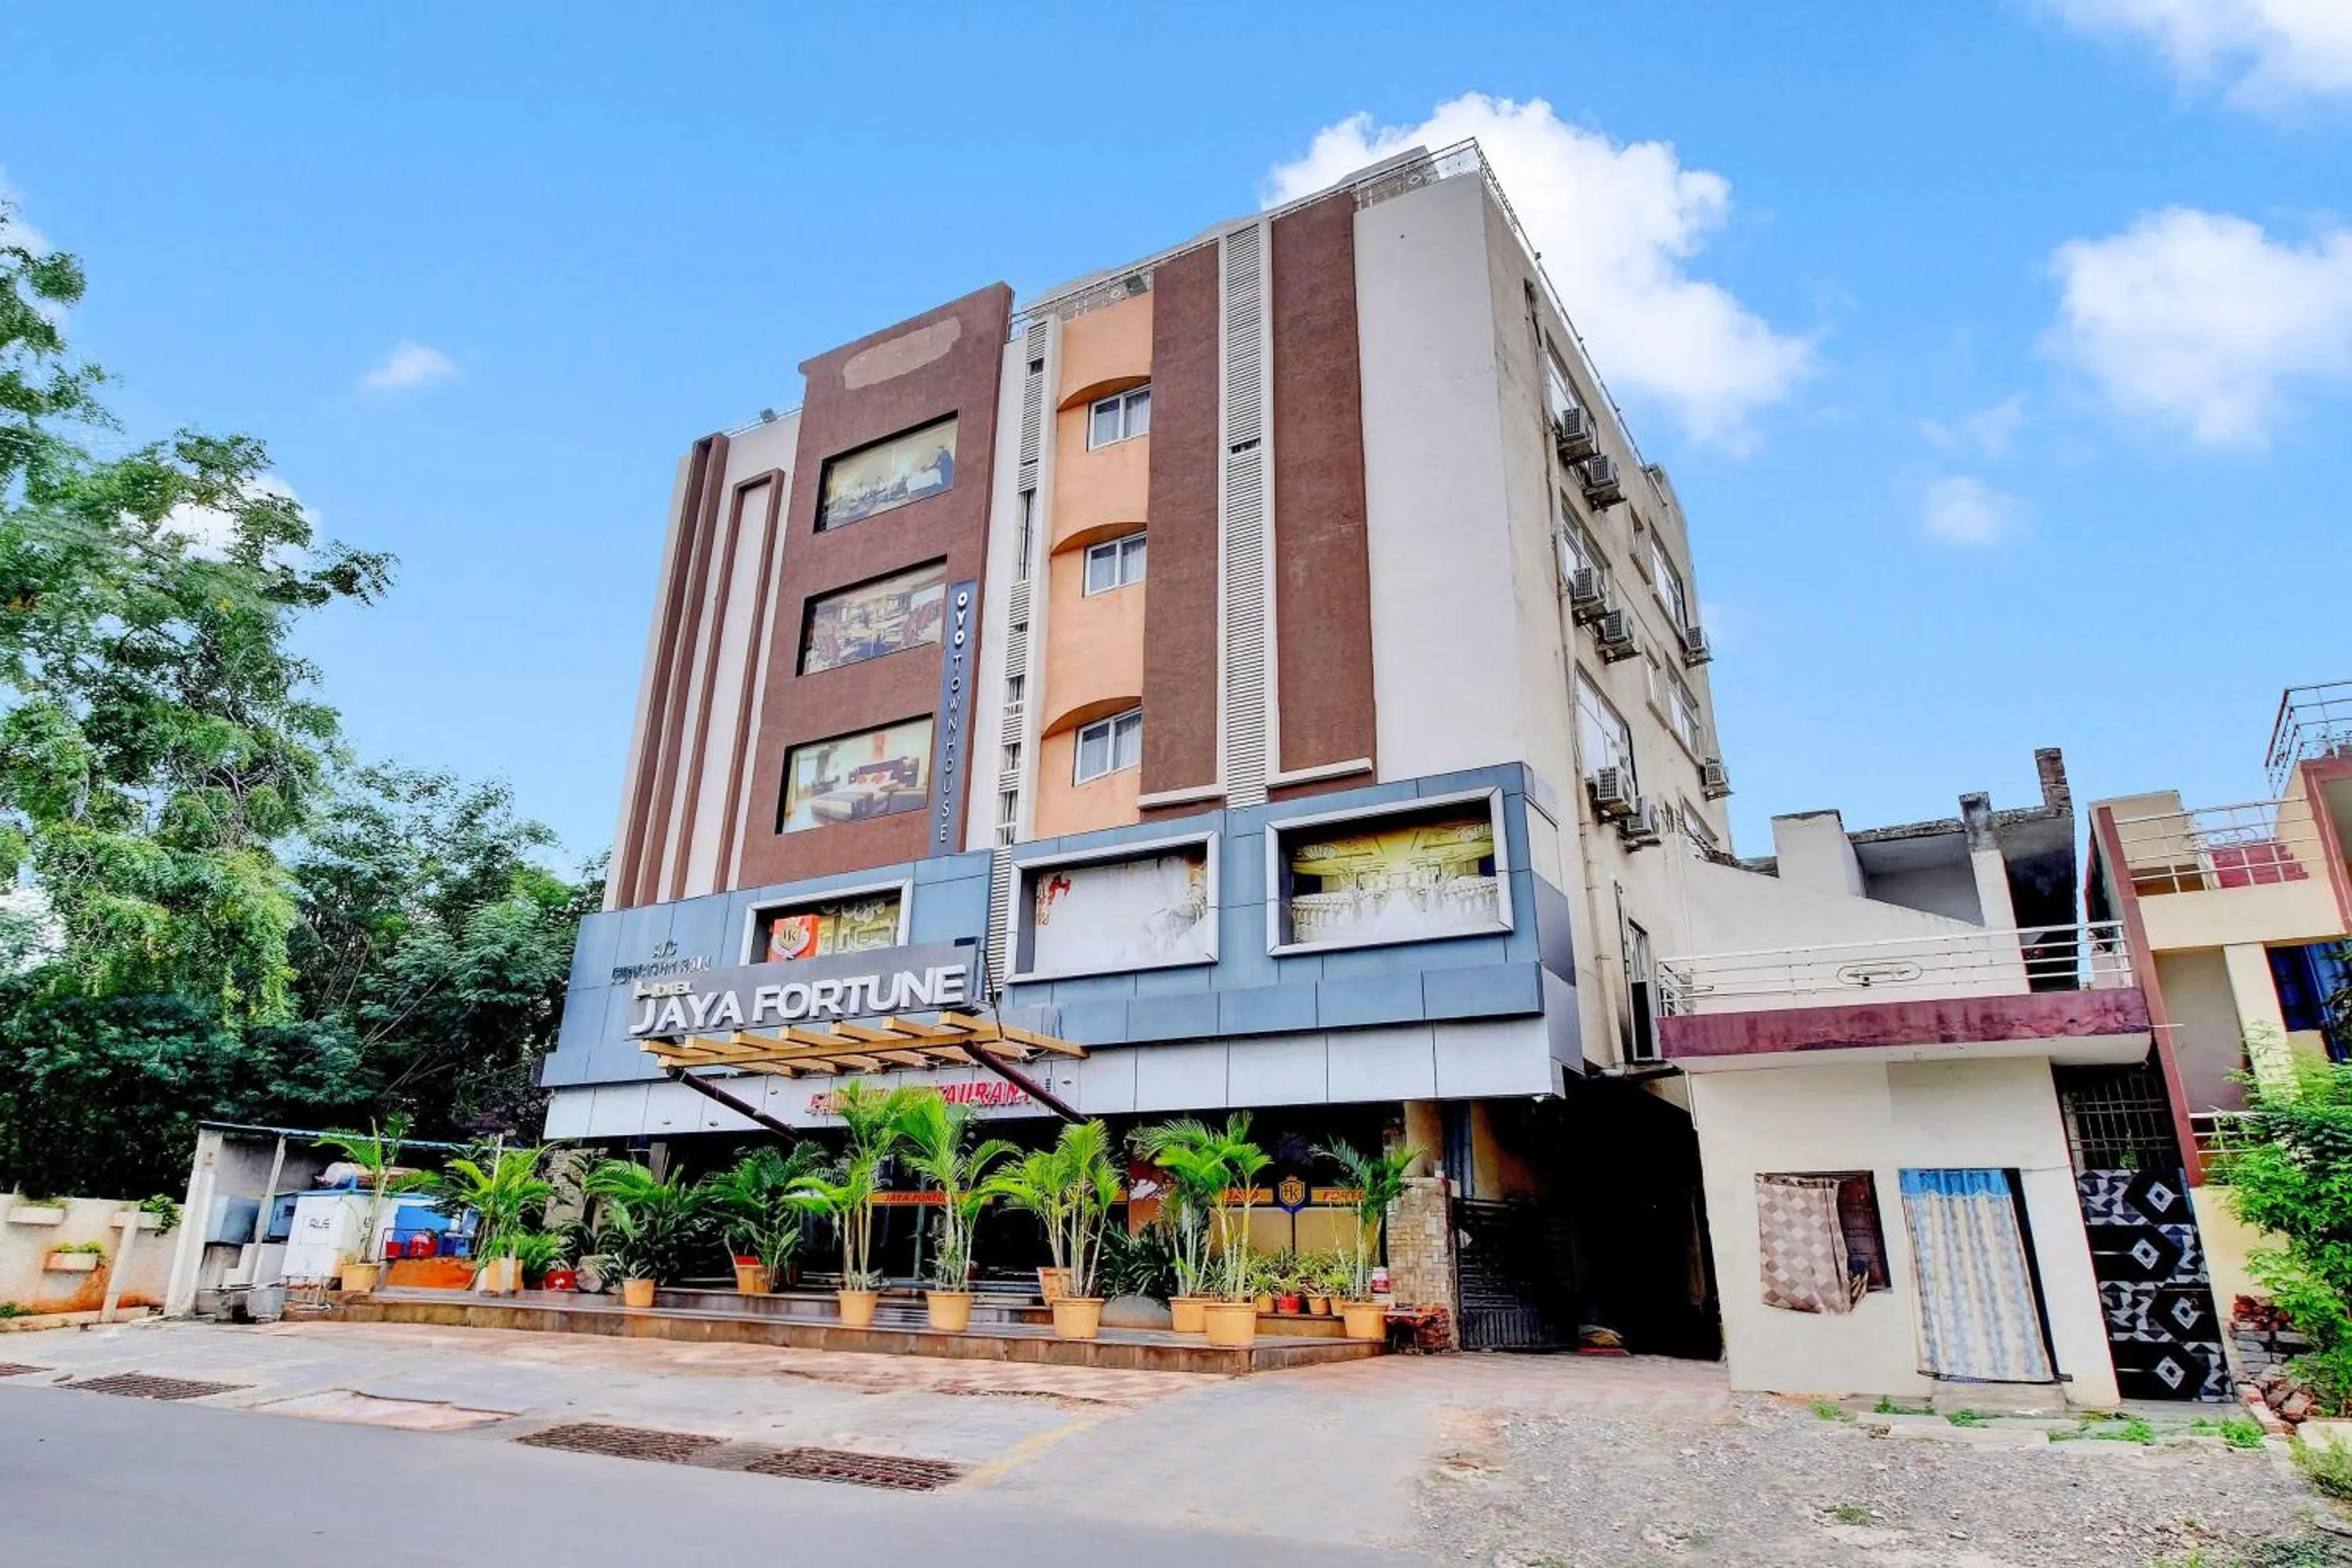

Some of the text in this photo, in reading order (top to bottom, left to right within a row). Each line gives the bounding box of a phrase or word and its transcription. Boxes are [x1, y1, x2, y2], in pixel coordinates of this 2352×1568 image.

[940, 590, 968, 843] OYO TOWNHOUSE
[629, 964, 967, 1035] JAYA FORTUNE
